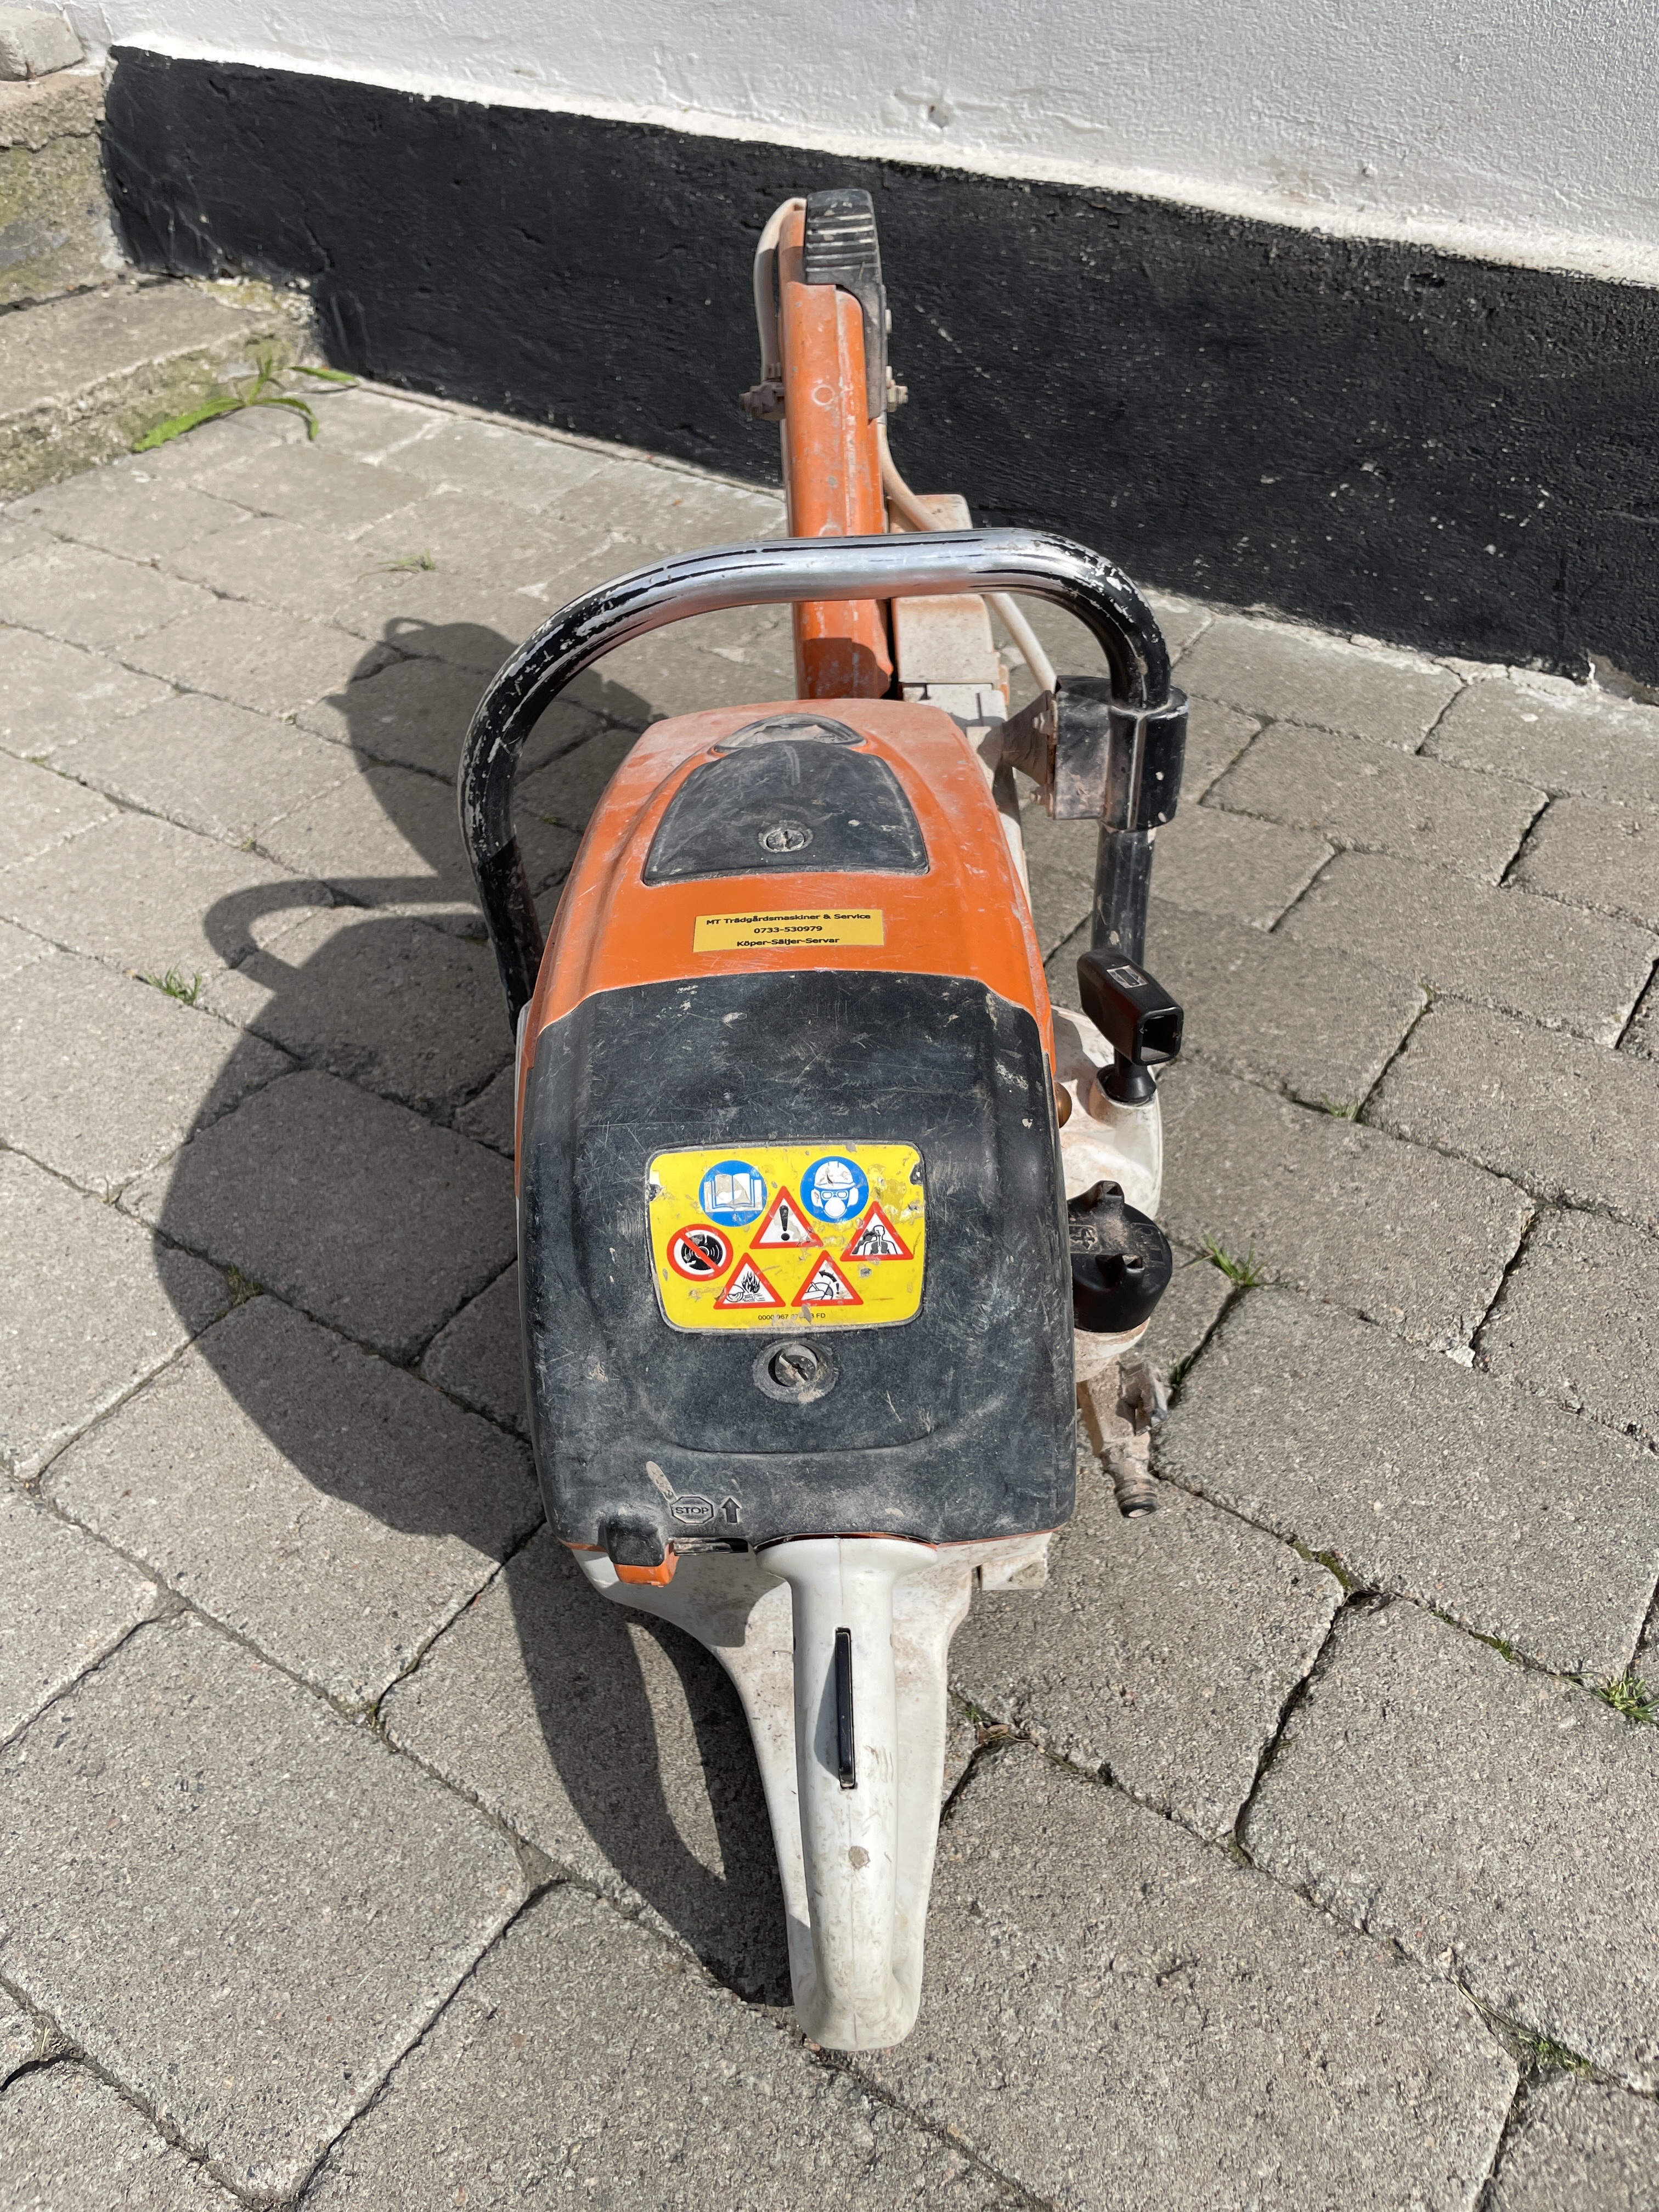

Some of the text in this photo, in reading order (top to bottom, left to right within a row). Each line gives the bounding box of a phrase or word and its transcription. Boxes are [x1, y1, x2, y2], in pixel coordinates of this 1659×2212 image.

[724, 915, 821, 923] Trädgårdsmaskiner
[754, 926, 822, 934] 0733-530979
[737, 938, 840, 946] Köper-Säljer-Servar
